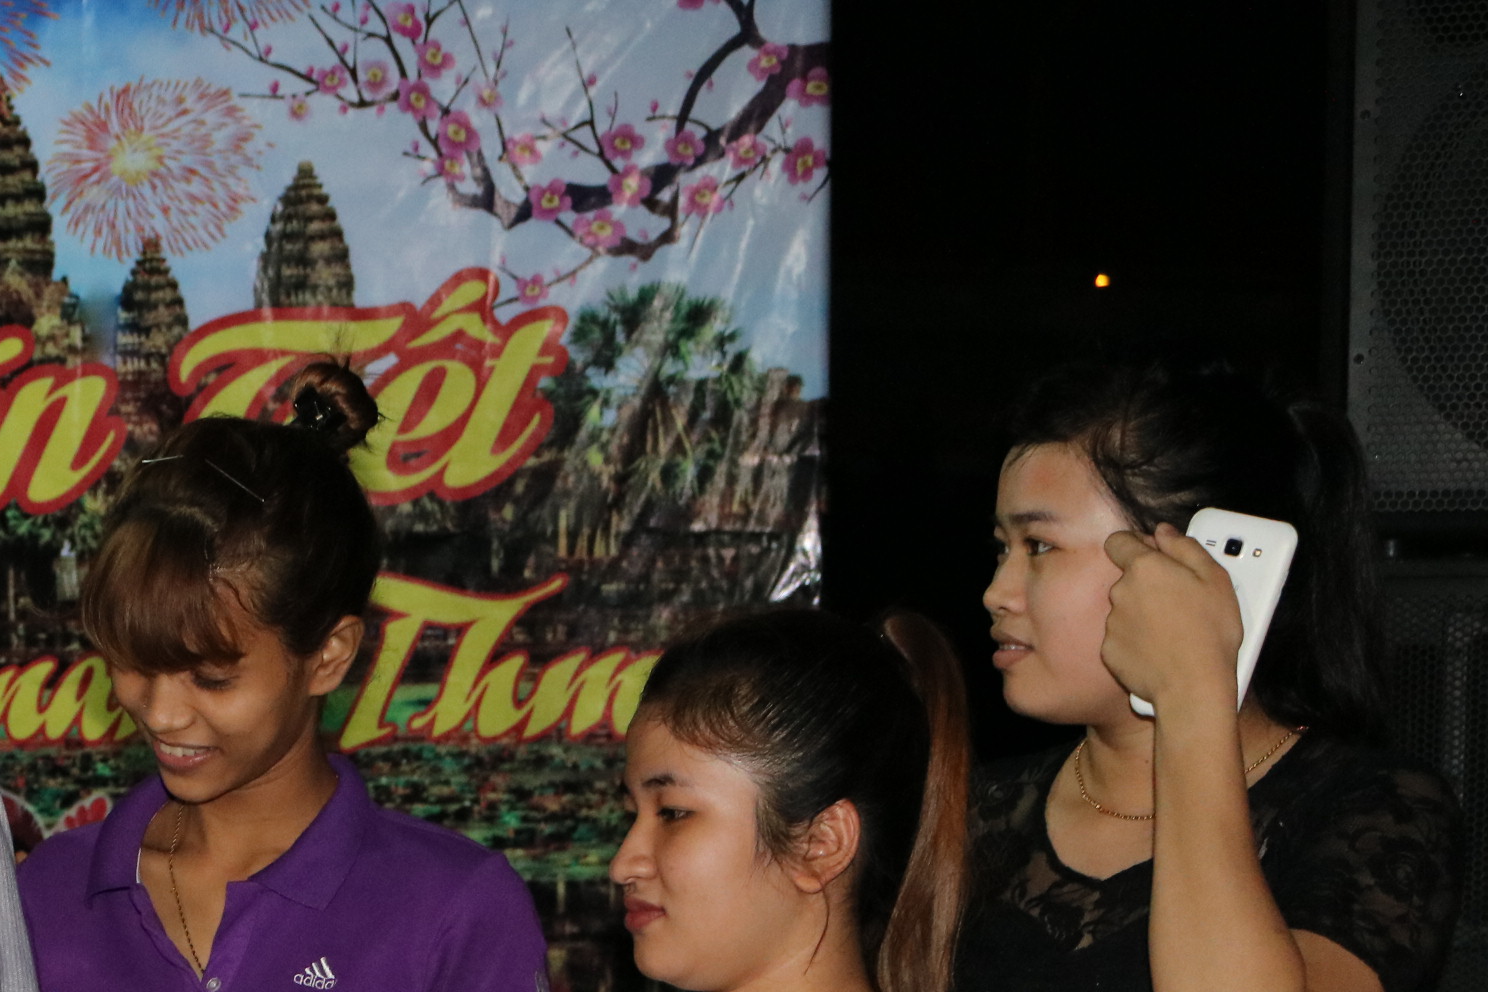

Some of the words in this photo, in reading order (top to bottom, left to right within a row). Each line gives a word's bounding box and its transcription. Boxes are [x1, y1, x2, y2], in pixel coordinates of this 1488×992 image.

[168, 267, 569, 504] Tết
[339, 571, 663, 753] Thm
[293, 971, 338, 990] adida
